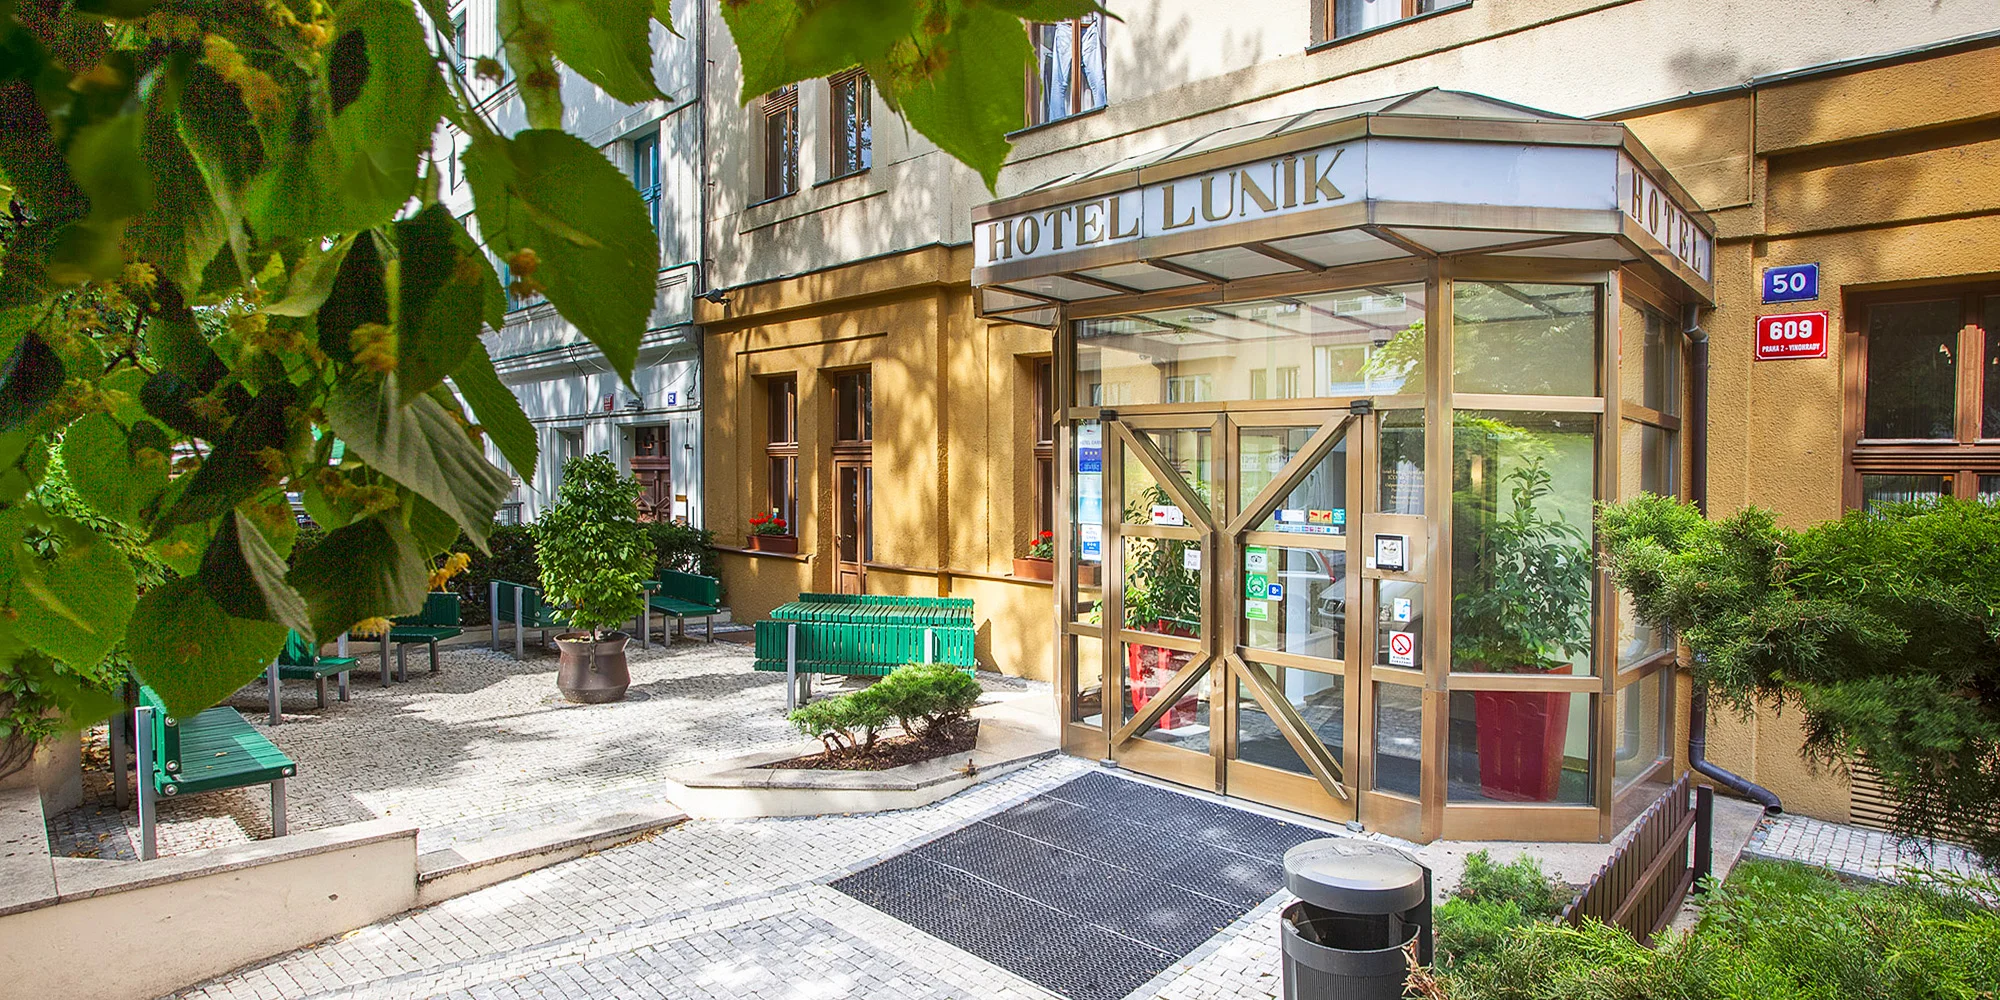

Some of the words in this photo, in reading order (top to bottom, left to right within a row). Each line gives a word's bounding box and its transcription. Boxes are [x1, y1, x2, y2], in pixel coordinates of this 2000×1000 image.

[988, 196, 1139, 262] HOTEL
[1632, 168, 1701, 273] HOTEL
[1772, 272, 1806, 294] 50
[1770, 320, 1812, 340] 609
[1789, 343, 1820, 351] VINOHRADY
